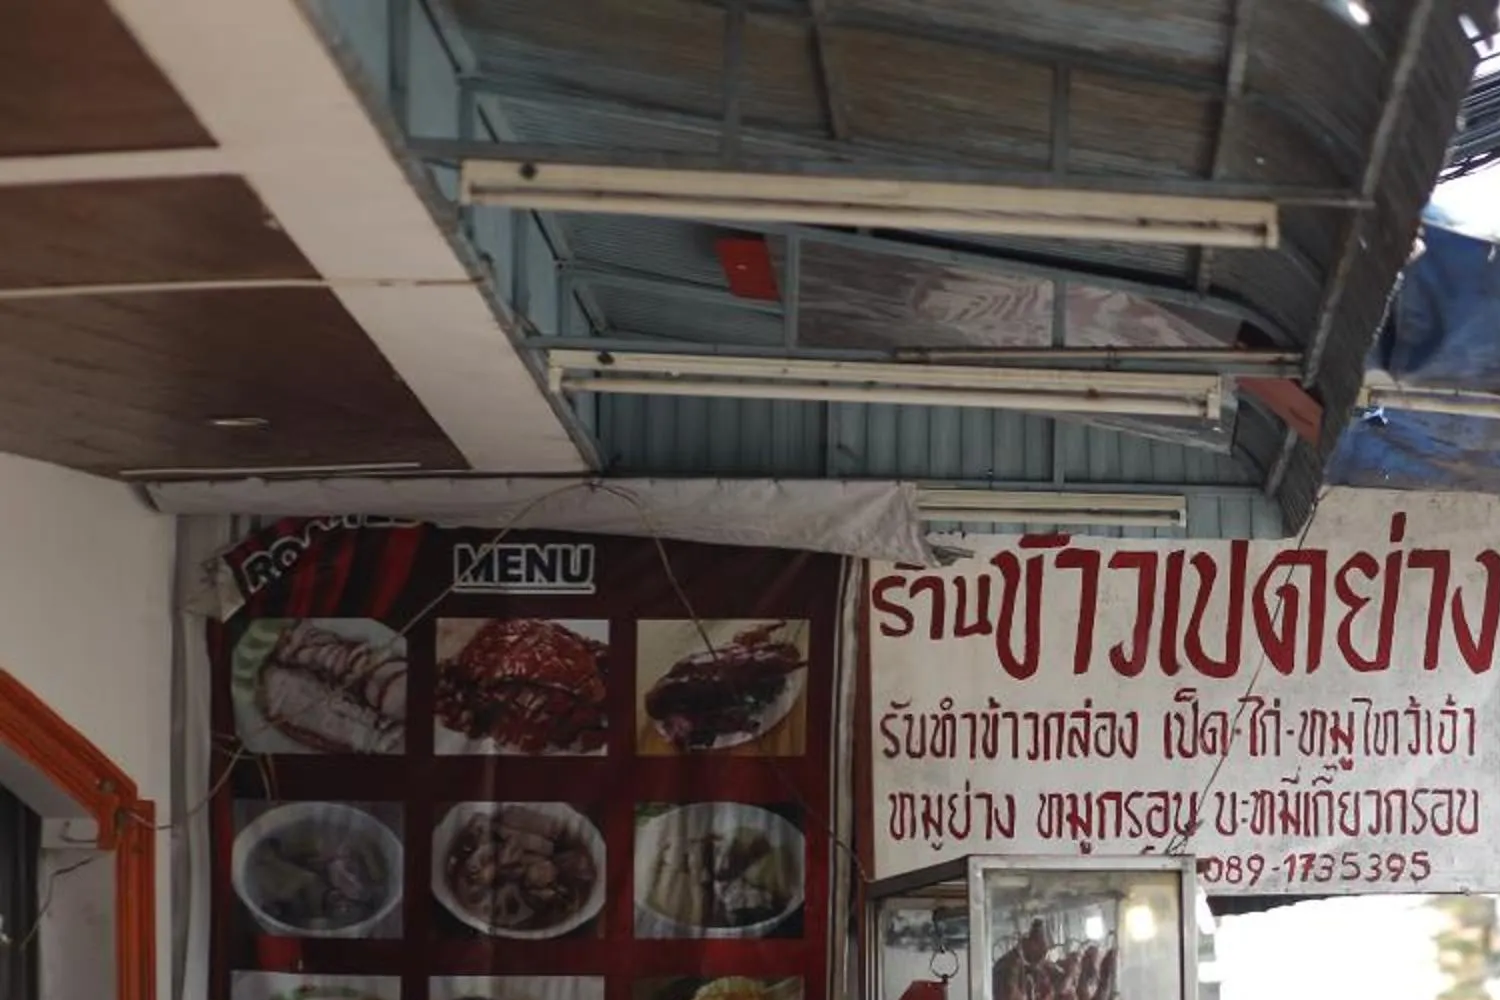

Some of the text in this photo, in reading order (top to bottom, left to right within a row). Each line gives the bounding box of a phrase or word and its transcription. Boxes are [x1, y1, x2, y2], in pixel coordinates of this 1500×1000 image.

[453, 544, 595, 588] MENU
[889, 780, 1016, 851] หมูย่าง
[1037, 792, 1199, 854] หมูกรอบ
[1203, 850, 1431, 886] 089-1735395
